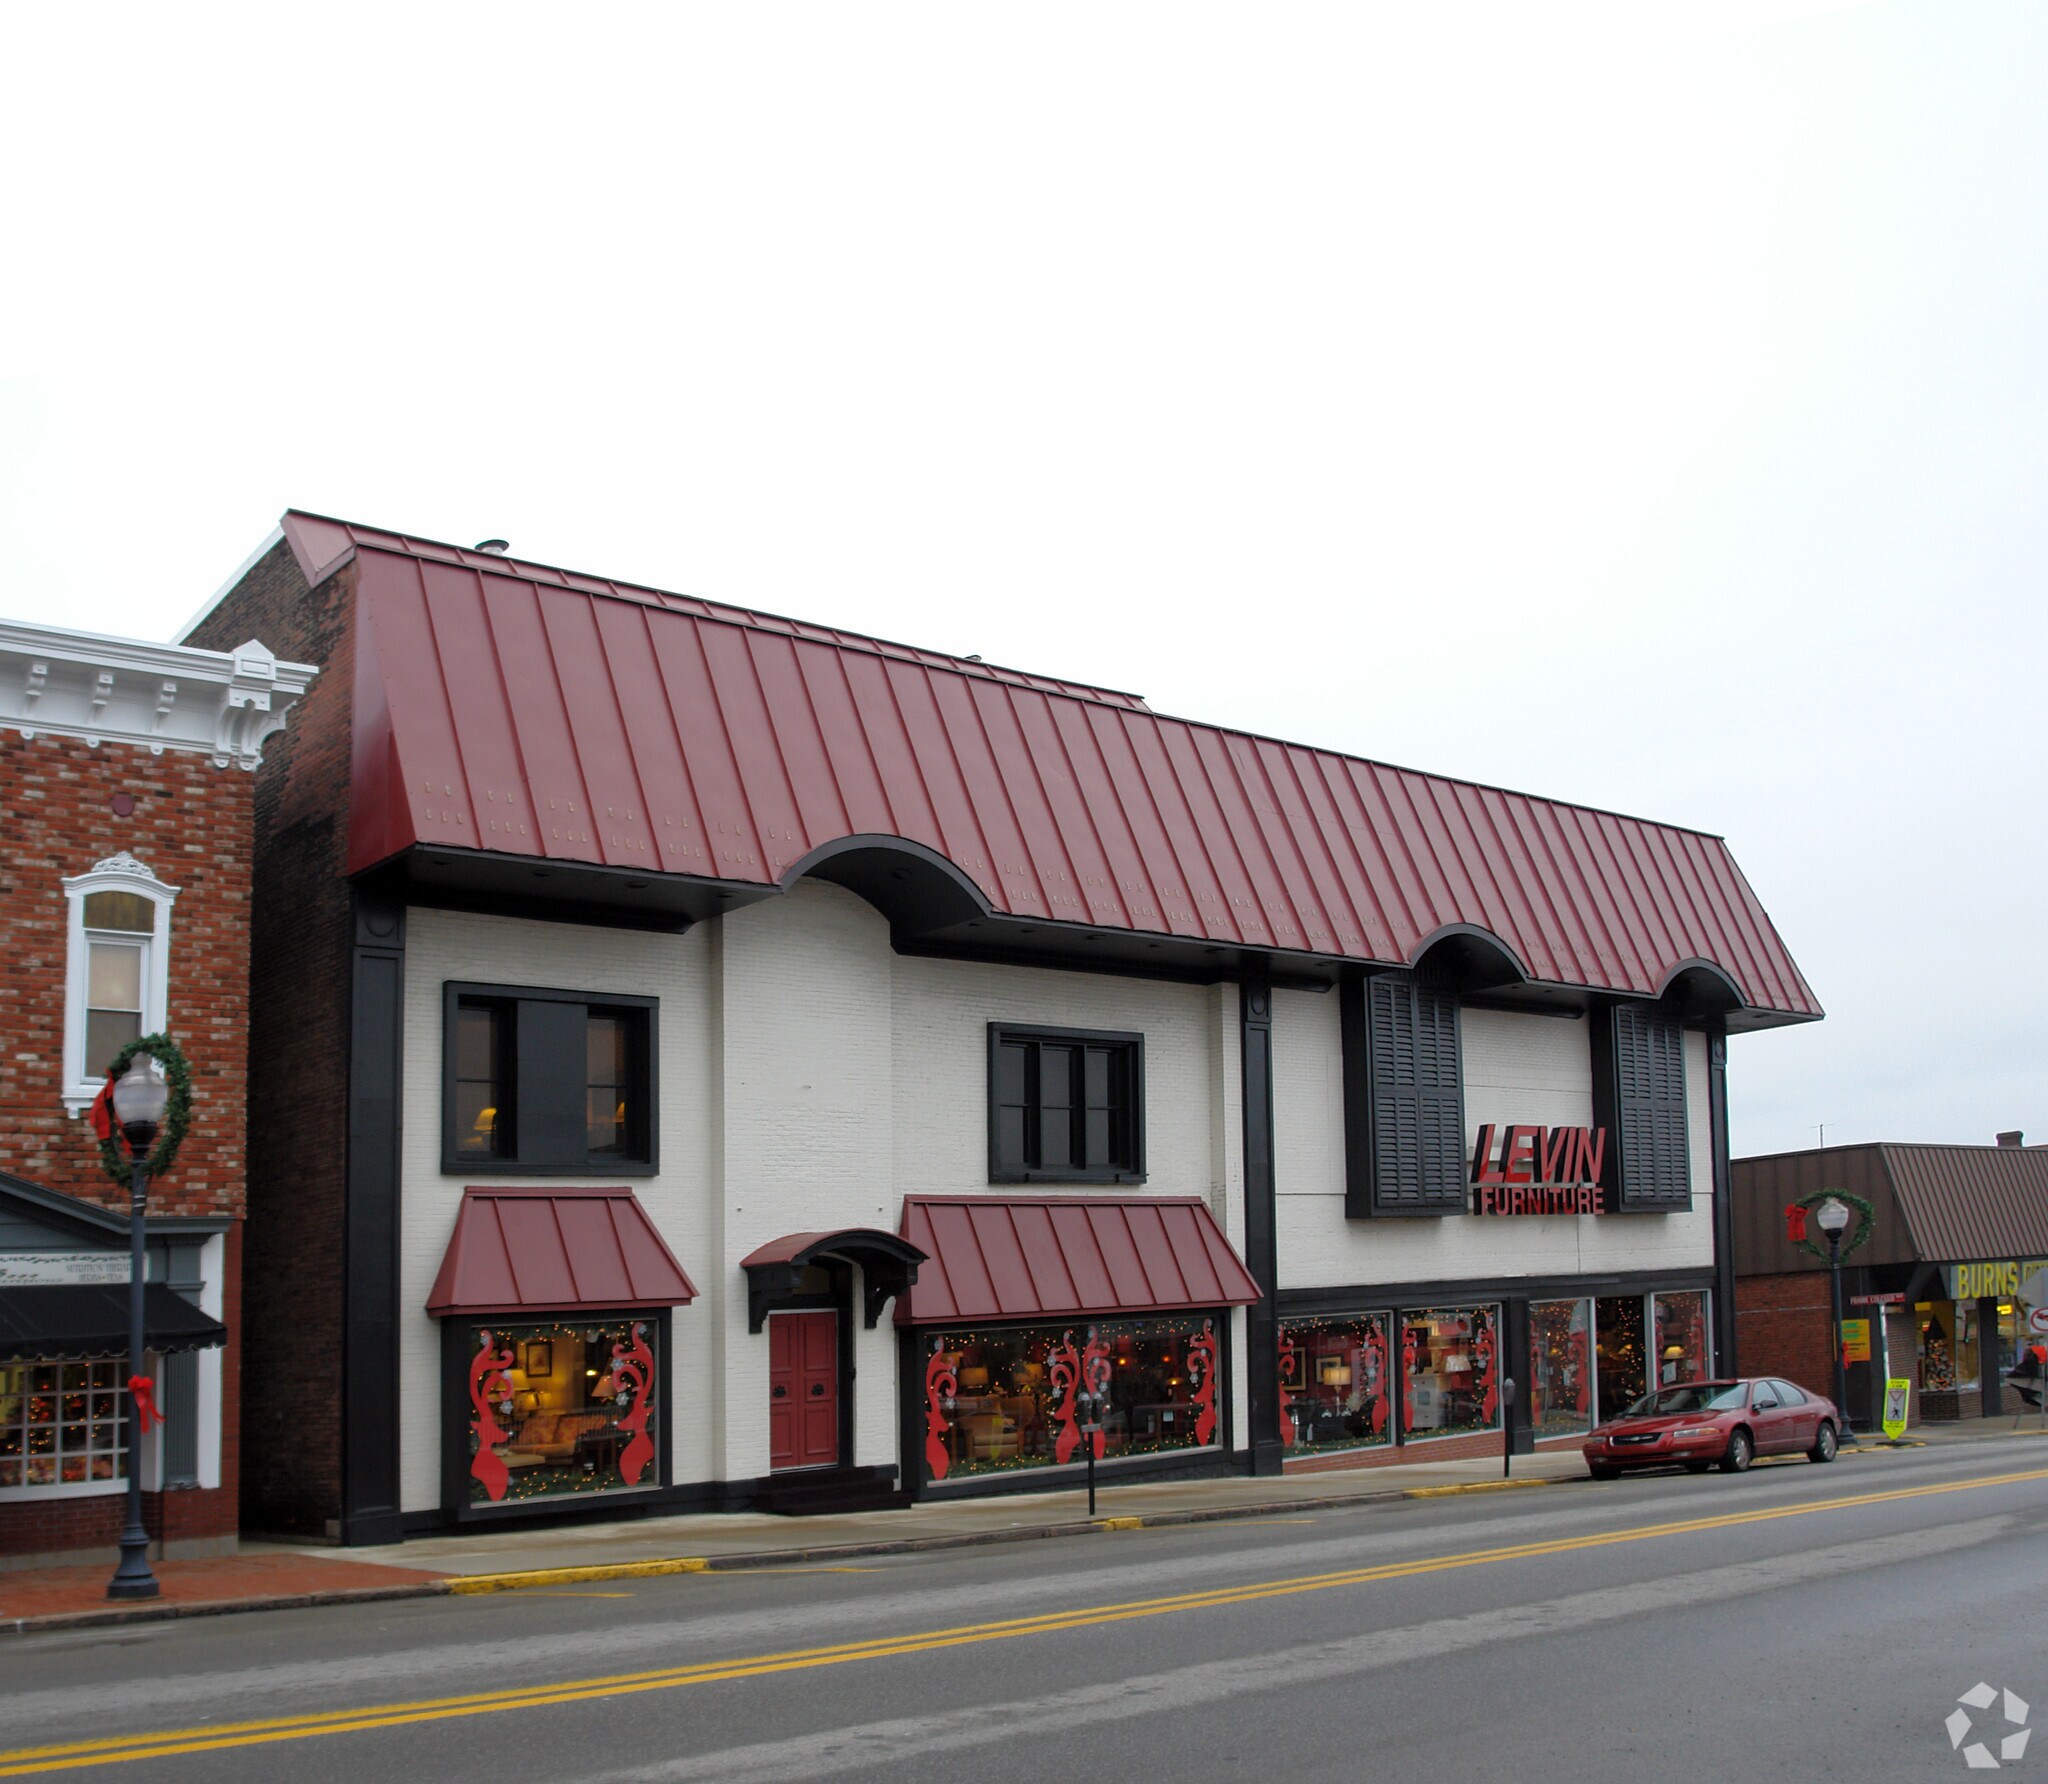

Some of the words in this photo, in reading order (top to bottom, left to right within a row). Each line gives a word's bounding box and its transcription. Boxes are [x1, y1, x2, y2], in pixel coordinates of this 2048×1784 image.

[1471, 1123, 1606, 1184] LEVIN
[1473, 1187, 1606, 1216] FURNITURE
[1957, 1262, 2019, 1299] BURNS
